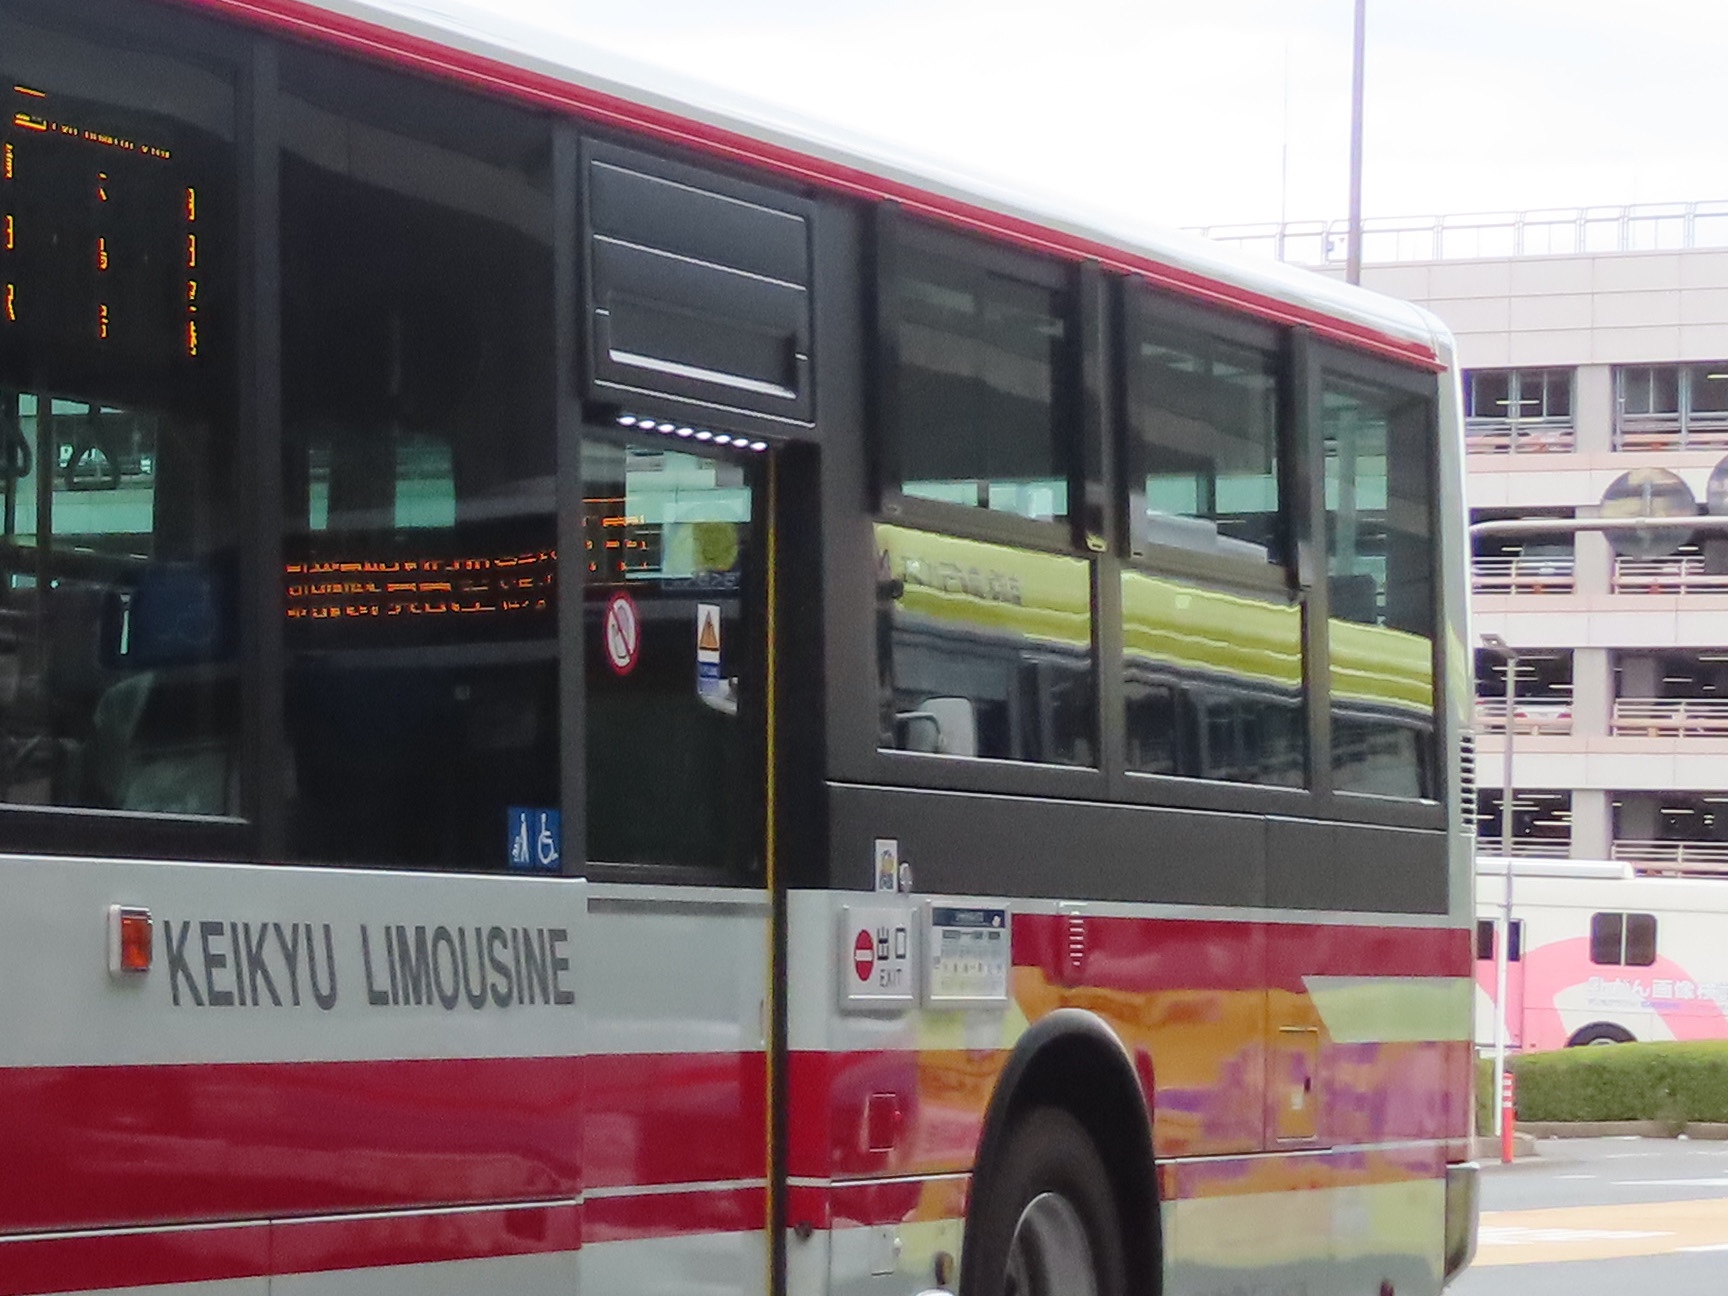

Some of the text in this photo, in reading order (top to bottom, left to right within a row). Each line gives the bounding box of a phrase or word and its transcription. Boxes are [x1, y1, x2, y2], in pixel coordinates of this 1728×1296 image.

[876, 925, 907, 962] 出口
[162, 919, 576, 1010] KEIKYU LIMOUSINE
[878, 968, 903, 988] EXIT
